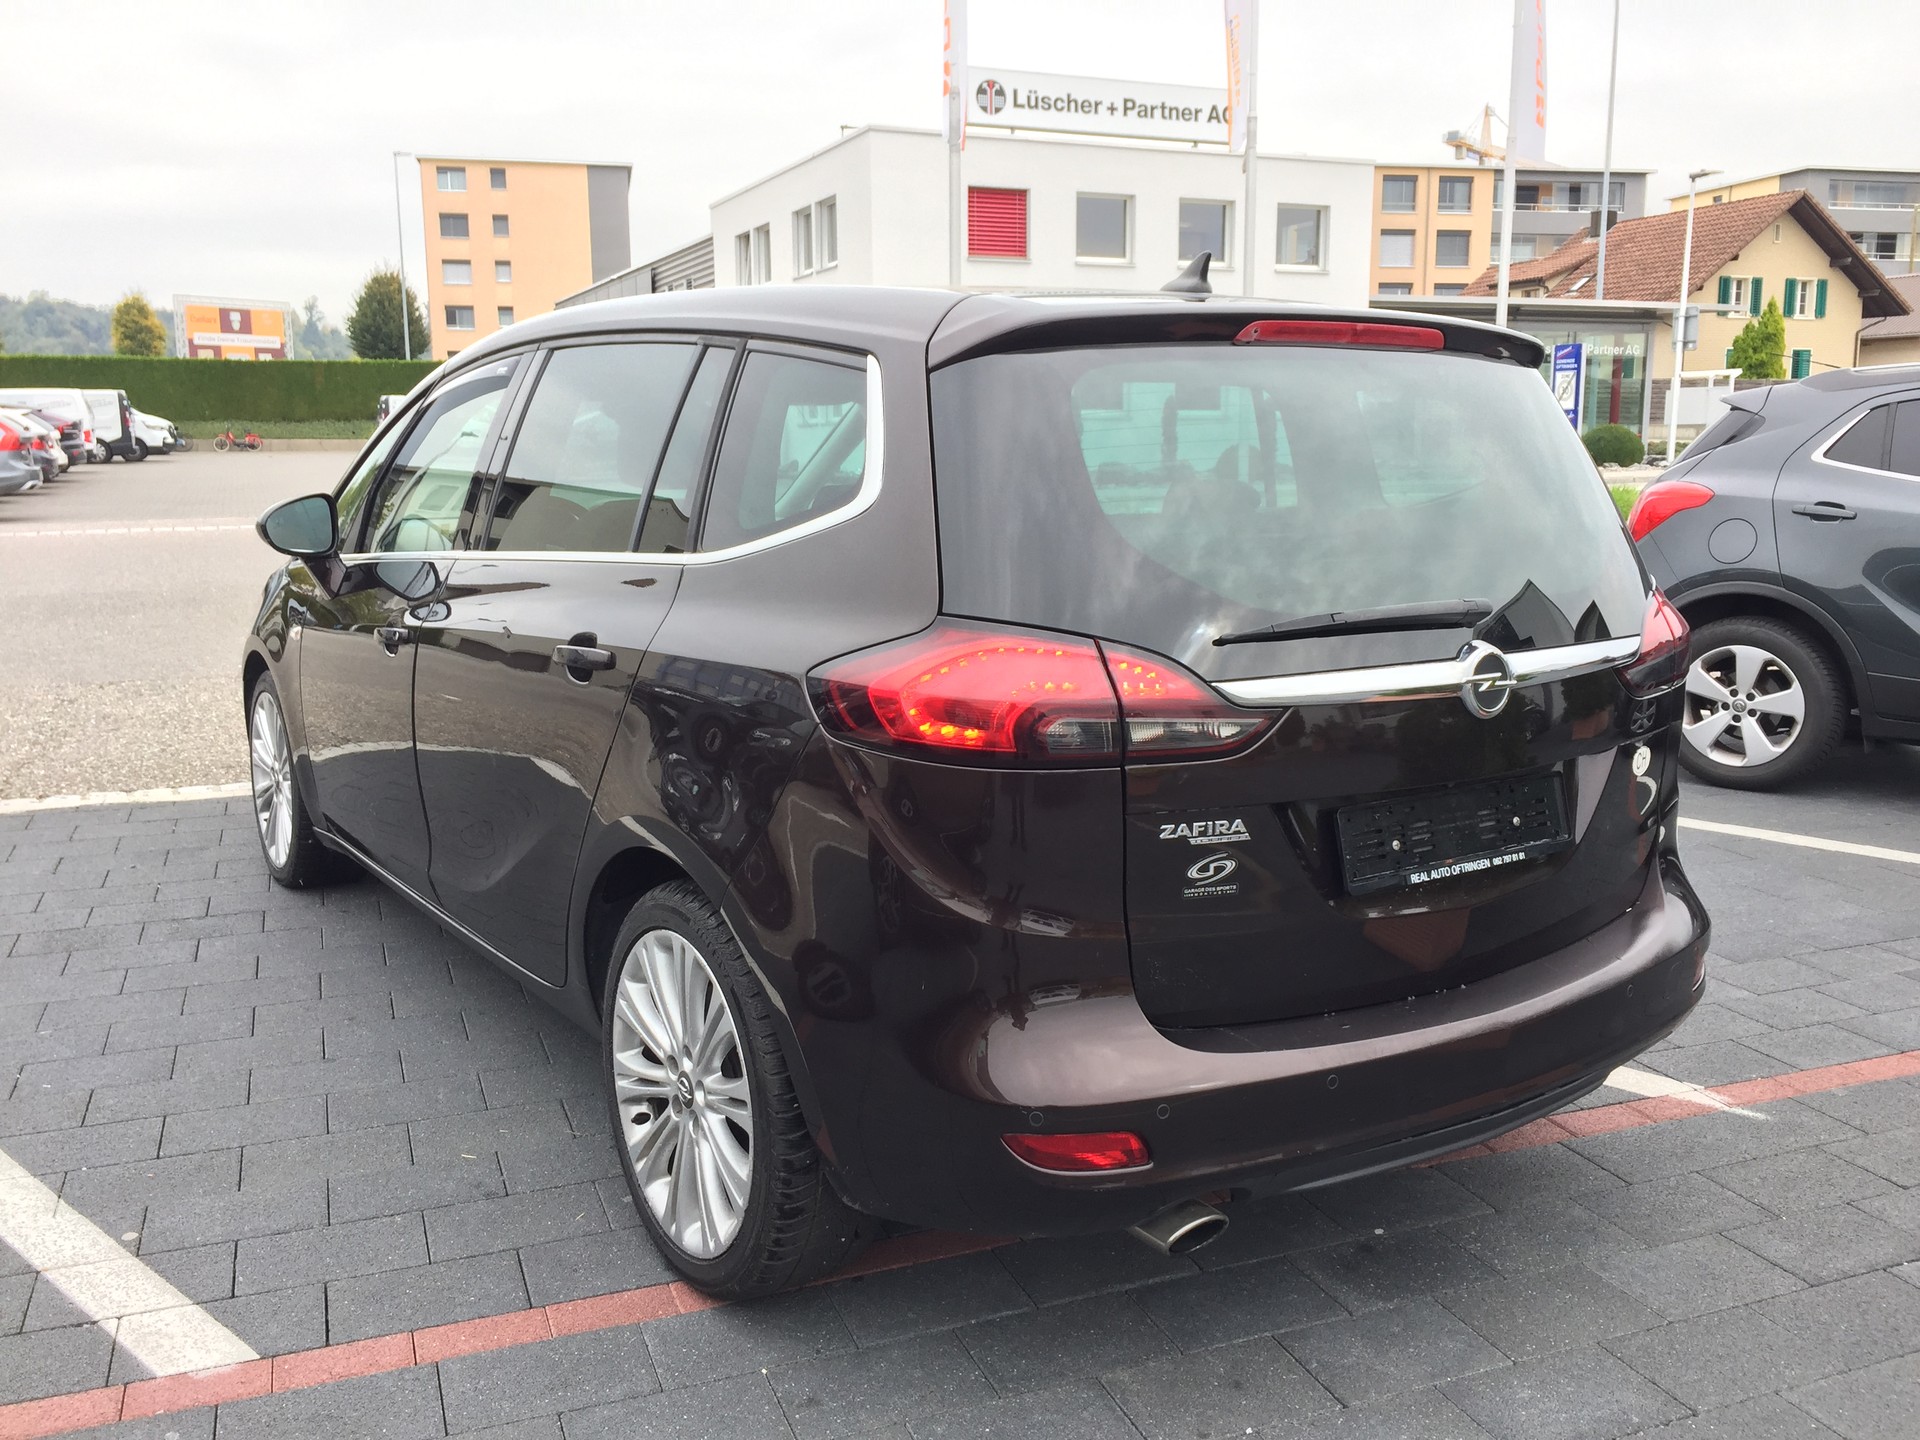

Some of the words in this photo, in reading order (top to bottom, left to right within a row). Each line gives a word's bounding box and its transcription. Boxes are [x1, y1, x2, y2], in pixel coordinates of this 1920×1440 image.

[1013, 88, 1103, 115] Lüscher
[1107, 102, 1118, 117] +
[1123, 98, 1202, 123] Partner
[1588, 346, 1624, 354] Partner
[1626, 346, 1640, 354] AG
[1636, 750, 1648, 769] CH
[1160, 819, 1247, 839] ZAFIRA
[1410, 871, 1430, 884] REAL
[1431, 867, 1450, 880] AUTO
[1452, 858, 1491, 875] OFTRINGEN
